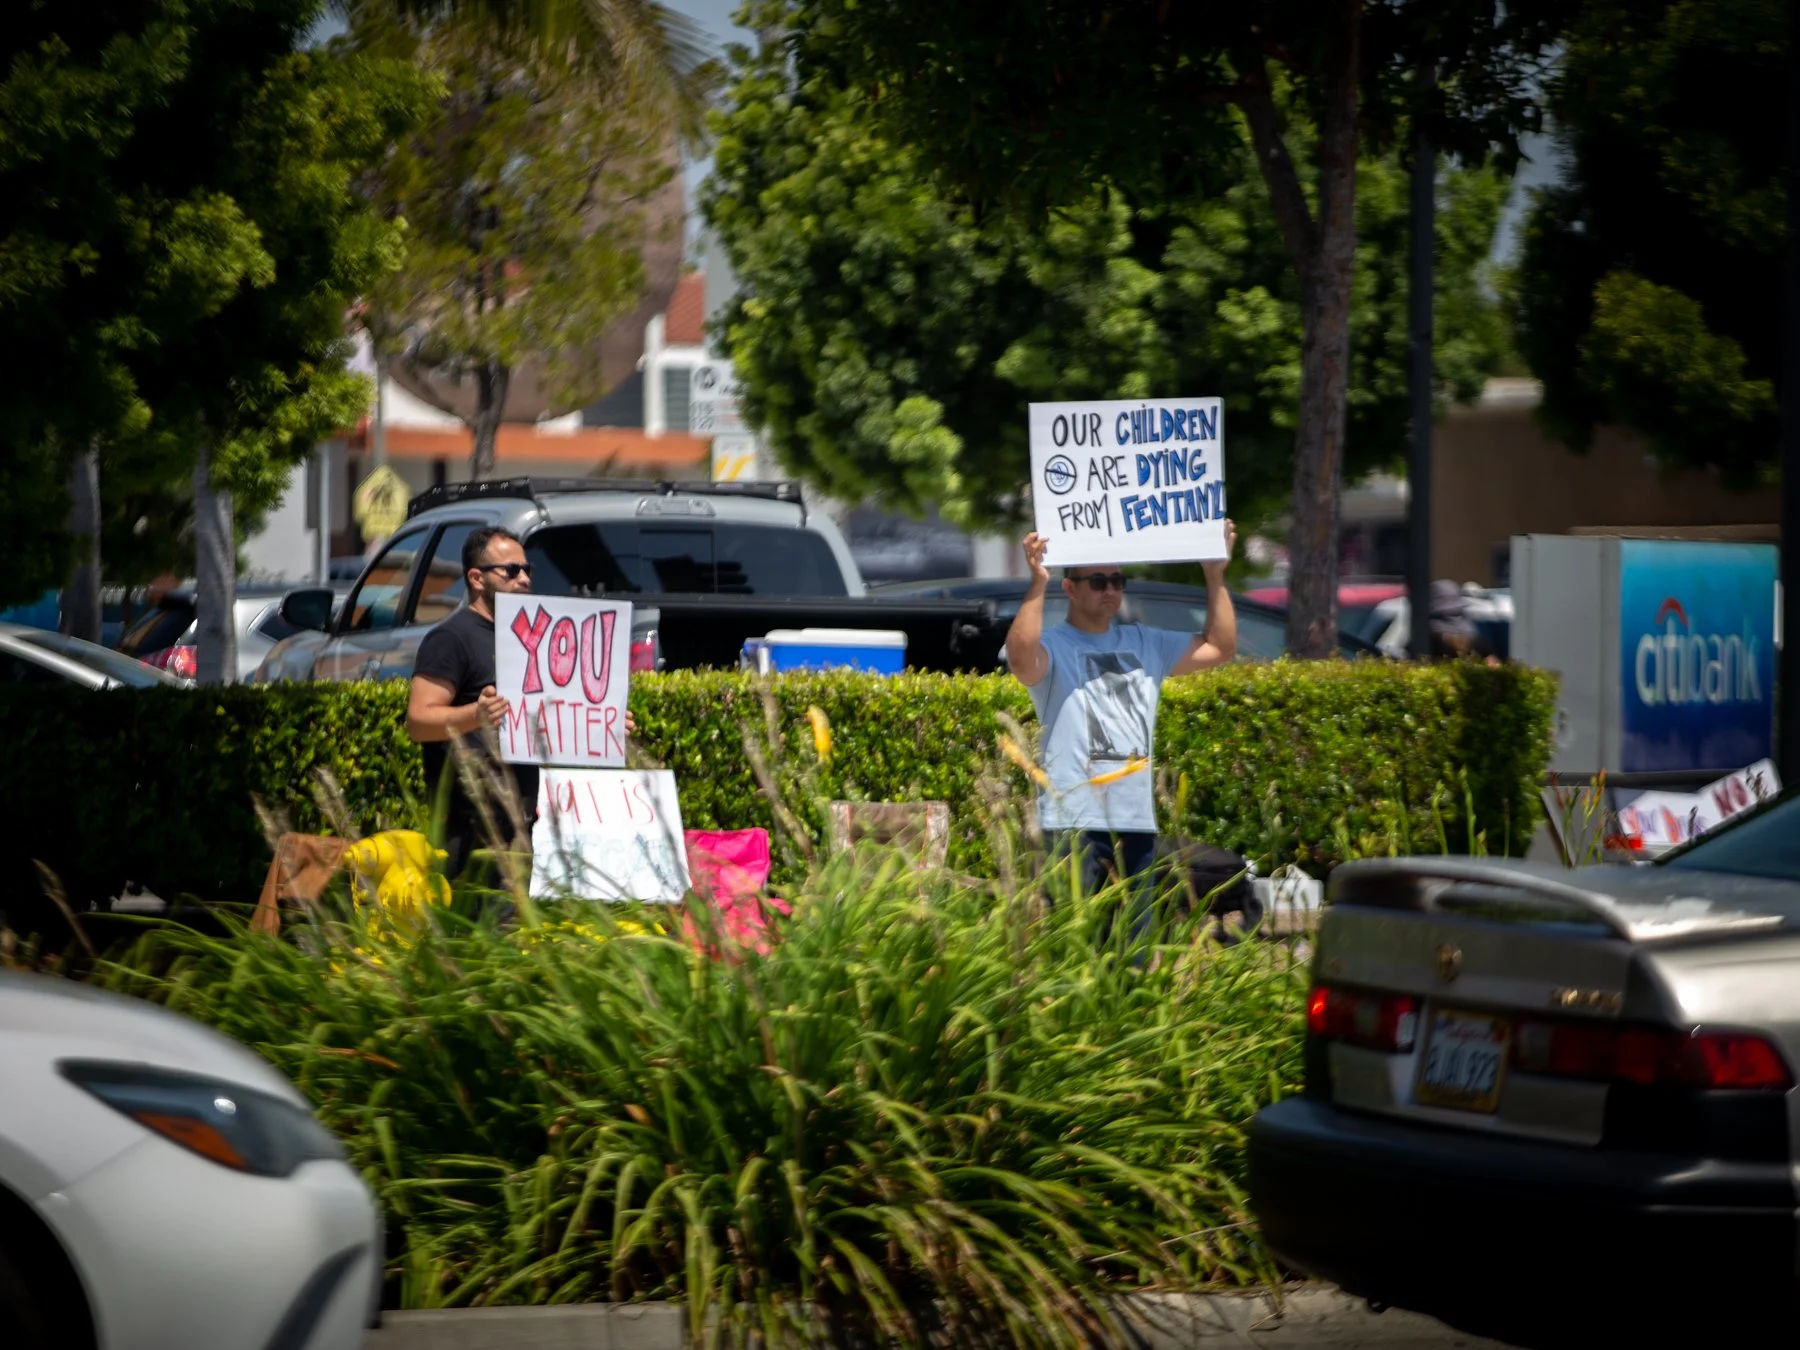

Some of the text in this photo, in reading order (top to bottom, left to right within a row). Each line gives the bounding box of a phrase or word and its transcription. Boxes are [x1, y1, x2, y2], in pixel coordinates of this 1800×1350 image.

[1052, 412, 1102, 447] OUR
[1087, 455, 1129, 491] ARE
[1057, 493, 1113, 537] FROM
[510, 603, 617, 704] YOU
[506, 695, 624, 758] MATTER
